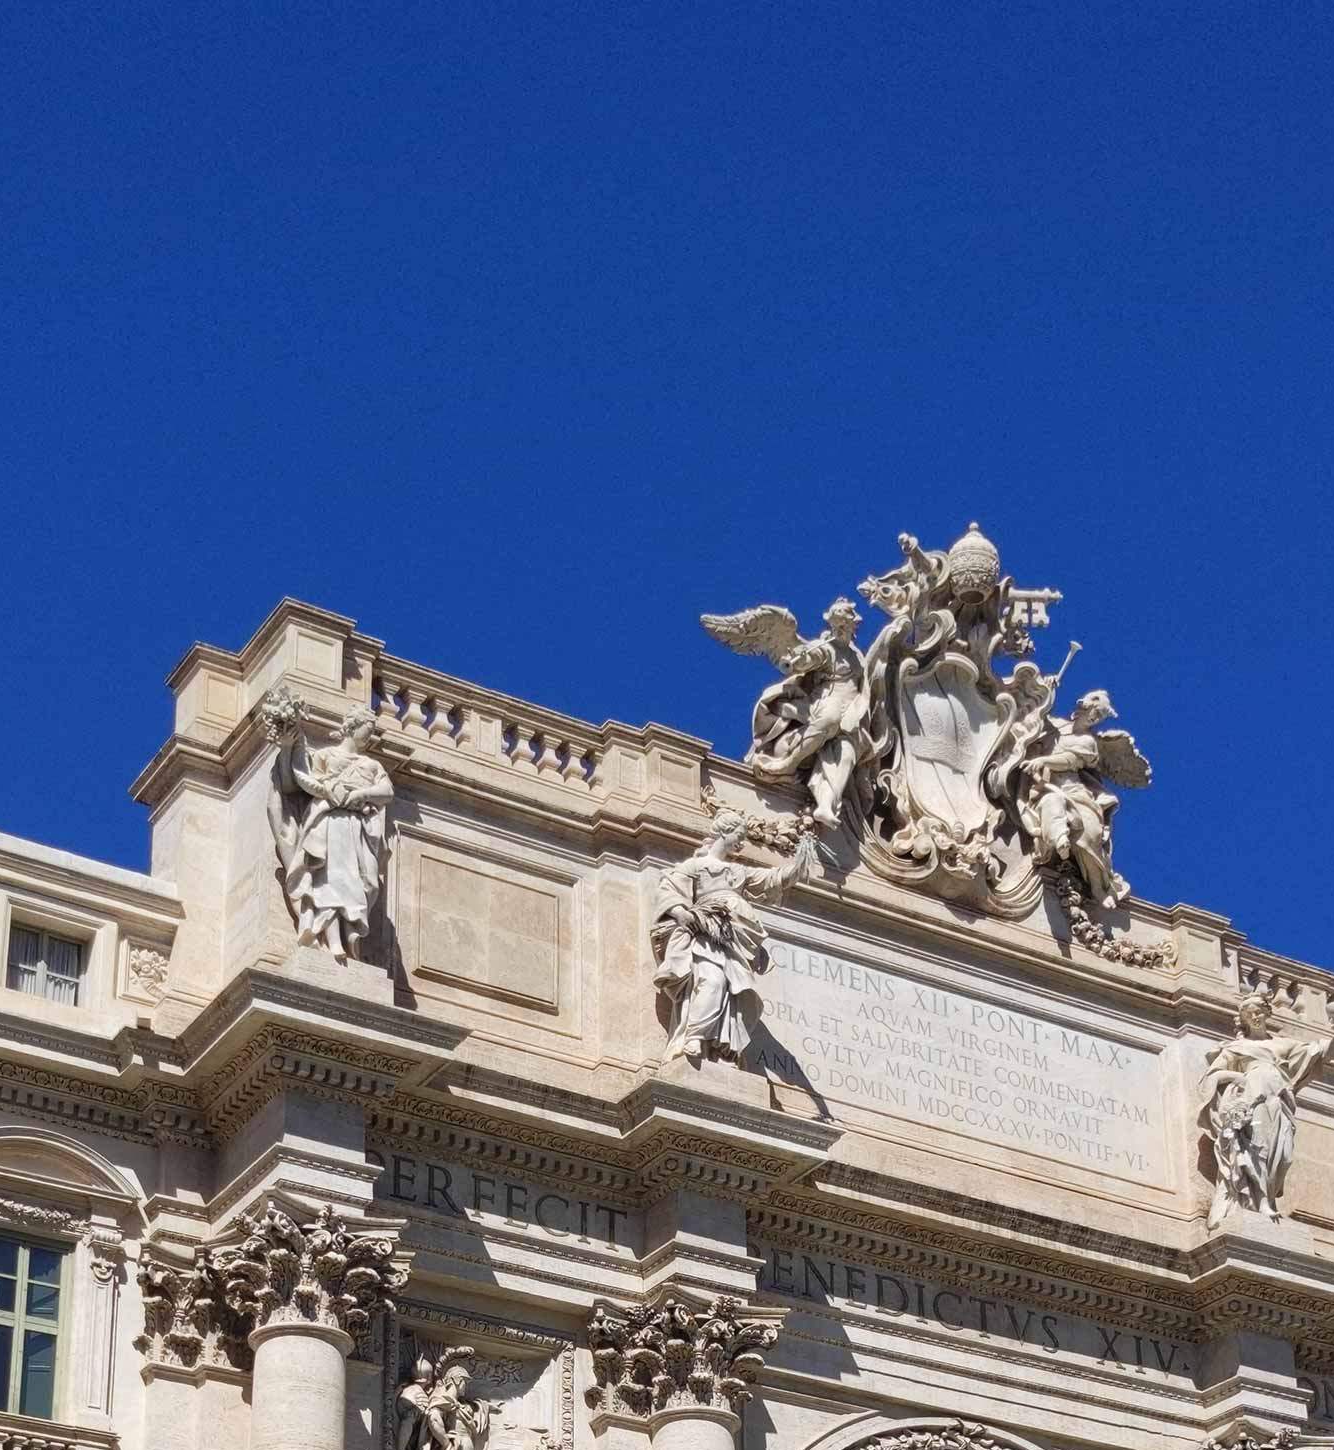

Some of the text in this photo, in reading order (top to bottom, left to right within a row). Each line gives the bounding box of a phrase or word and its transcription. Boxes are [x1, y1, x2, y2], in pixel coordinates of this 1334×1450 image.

[770, 945, 895, 1000] CLEMENS
[819, 1014, 842, 1036] ET
[851, 1024, 983, 1077] SALVBRITATE
[994, 1066, 1148, 1125] COMMENDATAM
[857, 1002, 1049, 1071] AQVAM VIRGINEM
[756, 1049, 821, 1082] ANNO
[829, 1069, 907, 1106] DOMINI
[802, 1036, 1103, 1135] CVLTV MAGNIFICO ORNAVIT
